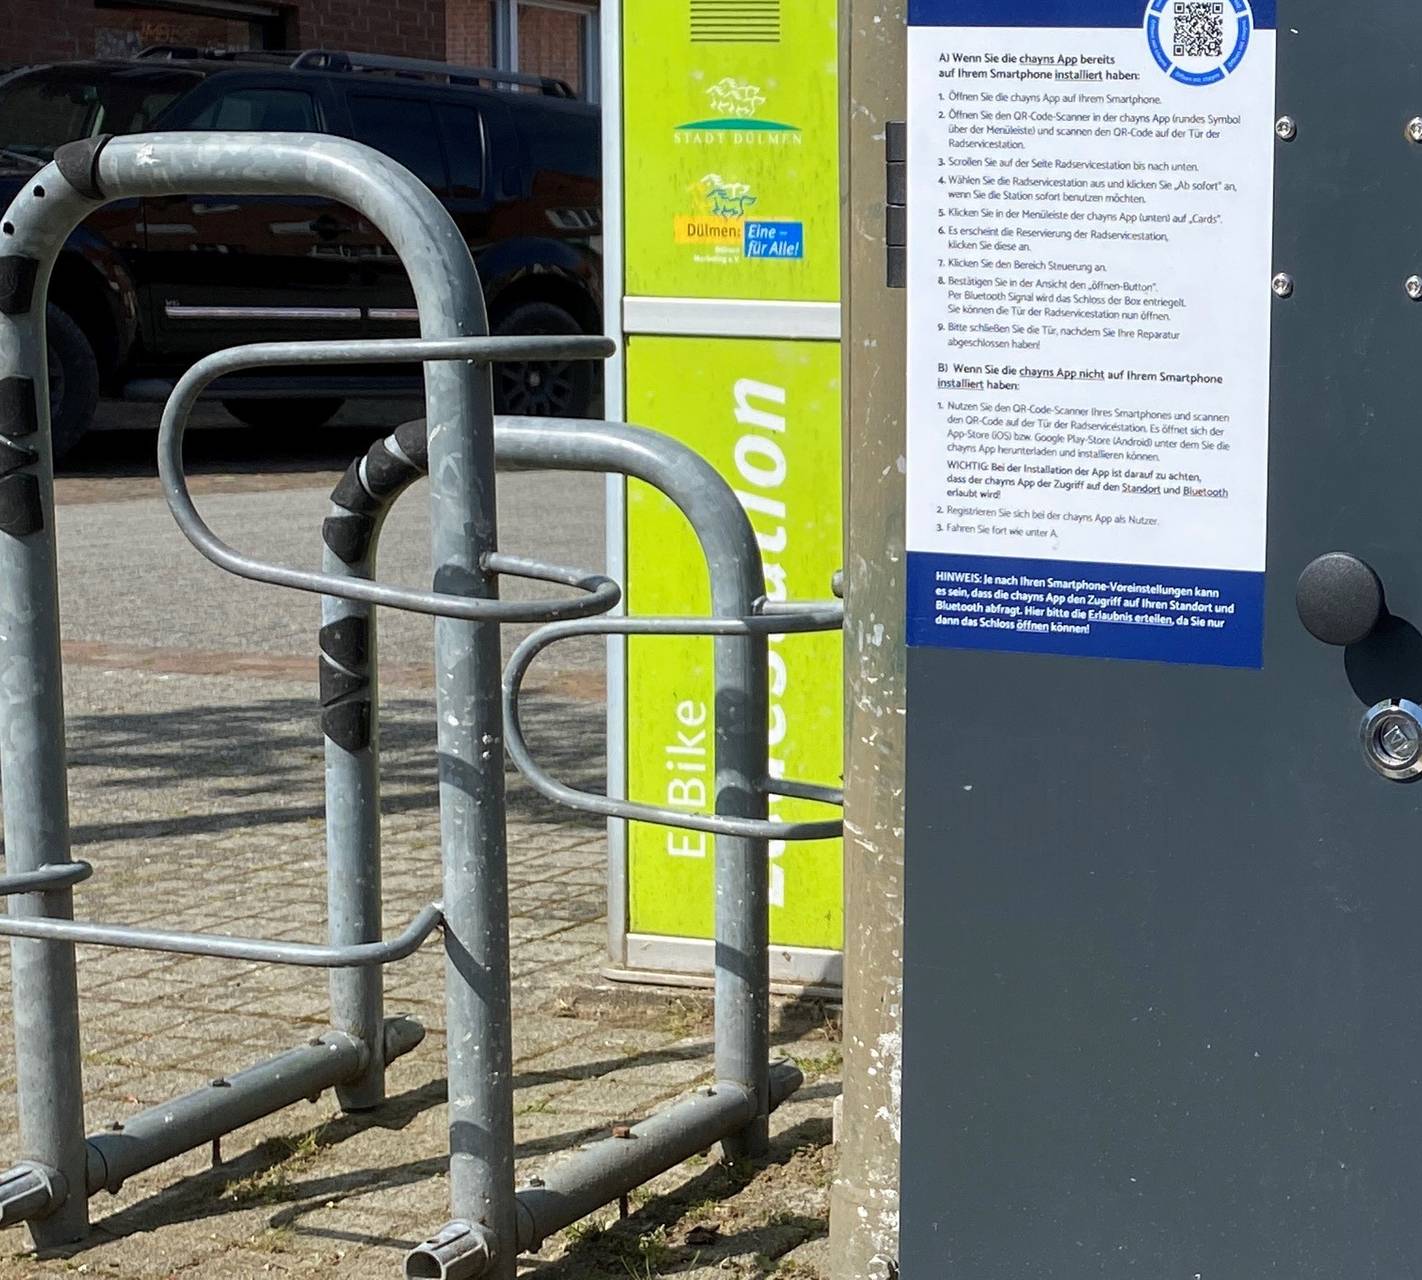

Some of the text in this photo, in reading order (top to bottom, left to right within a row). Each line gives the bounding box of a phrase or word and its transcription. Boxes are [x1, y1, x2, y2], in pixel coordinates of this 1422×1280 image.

[951, 52, 981, 62] Wenn
[983, 52, 999, 62] Sie
[1000, 53, 1017, 62] die
[1018, 53, 1055, 65] chayns
[1056, 53, 1078, 65] App
[1079, 53, 1115, 63] bereits
[938, 68, 1140, 81] auf Ihrem Smartphone installiert haben:
[674, 131, 801, 145] STADT DÜLMEN
[687, 223, 741, 238] Dülmen:
[748, 223, 777, 239] Eine
[747, 240, 800, 257] für Alle!
[937, 363, 1223, 384] B) Wenn Sie die chayns App nicht auf Ihrem Smartphone
[937, 378, 984, 389] installiert
[990, 462, 1005, 472] Bei
[1006, 462, 1021, 473] der
[1023, 463, 1072, 475] Installation
[1074, 465, 1089, 476] der
[1091, 466, 1110, 479] App
[1111, 467, 1122, 477] ist
[1123, 468, 1154, 478] darauf
[1154, 471, 1166, 479] zu
[946, 473, 1228, 496] dass der chayns App der Zugriff auf den Standort und Bluetooth
[982, 573, 993, 583] Je
[994, 575, 1018, 585] nach
[1019, 575, 1045, 586] Ihren
[1046, 577, 1192, 596] Smartphone-Voreinstellungen
[1194, 585, 1219, 596] kann
[970, 587, 992, 598] dass
[993, 589, 1009, 599] die
[1009, 590, 1044, 603] chayns
[1044, 592, 1066, 605] App
[1066, 593, 1086, 603] den
[1086, 594, 1122, 607] Zugriff
[1122, 597, 1140, 606] auf
[1141, 597, 1167, 608] Ihren
[1169, 599, 1213, 611] Standort
[1214, 602, 1234, 612] und
[935, 600, 983, 612] Bluetooth
[1024, 605, 1045, 616] Hier
[1046, 607, 1069, 617] bitte
[1070, 608, 1086, 618] die
[1087, 609, 1133, 621] Erlaubnis
[1175, 614, 1189, 625] da
[1190, 615, 1205, 626] Sie
[1206, 619, 1225, 627] nur
[934, 615, 959, 626] dann
[960, 616, 978, 627] das
[978, 617, 1015, 629] Schloss
[1016, 619, 1049, 630] öffnen
